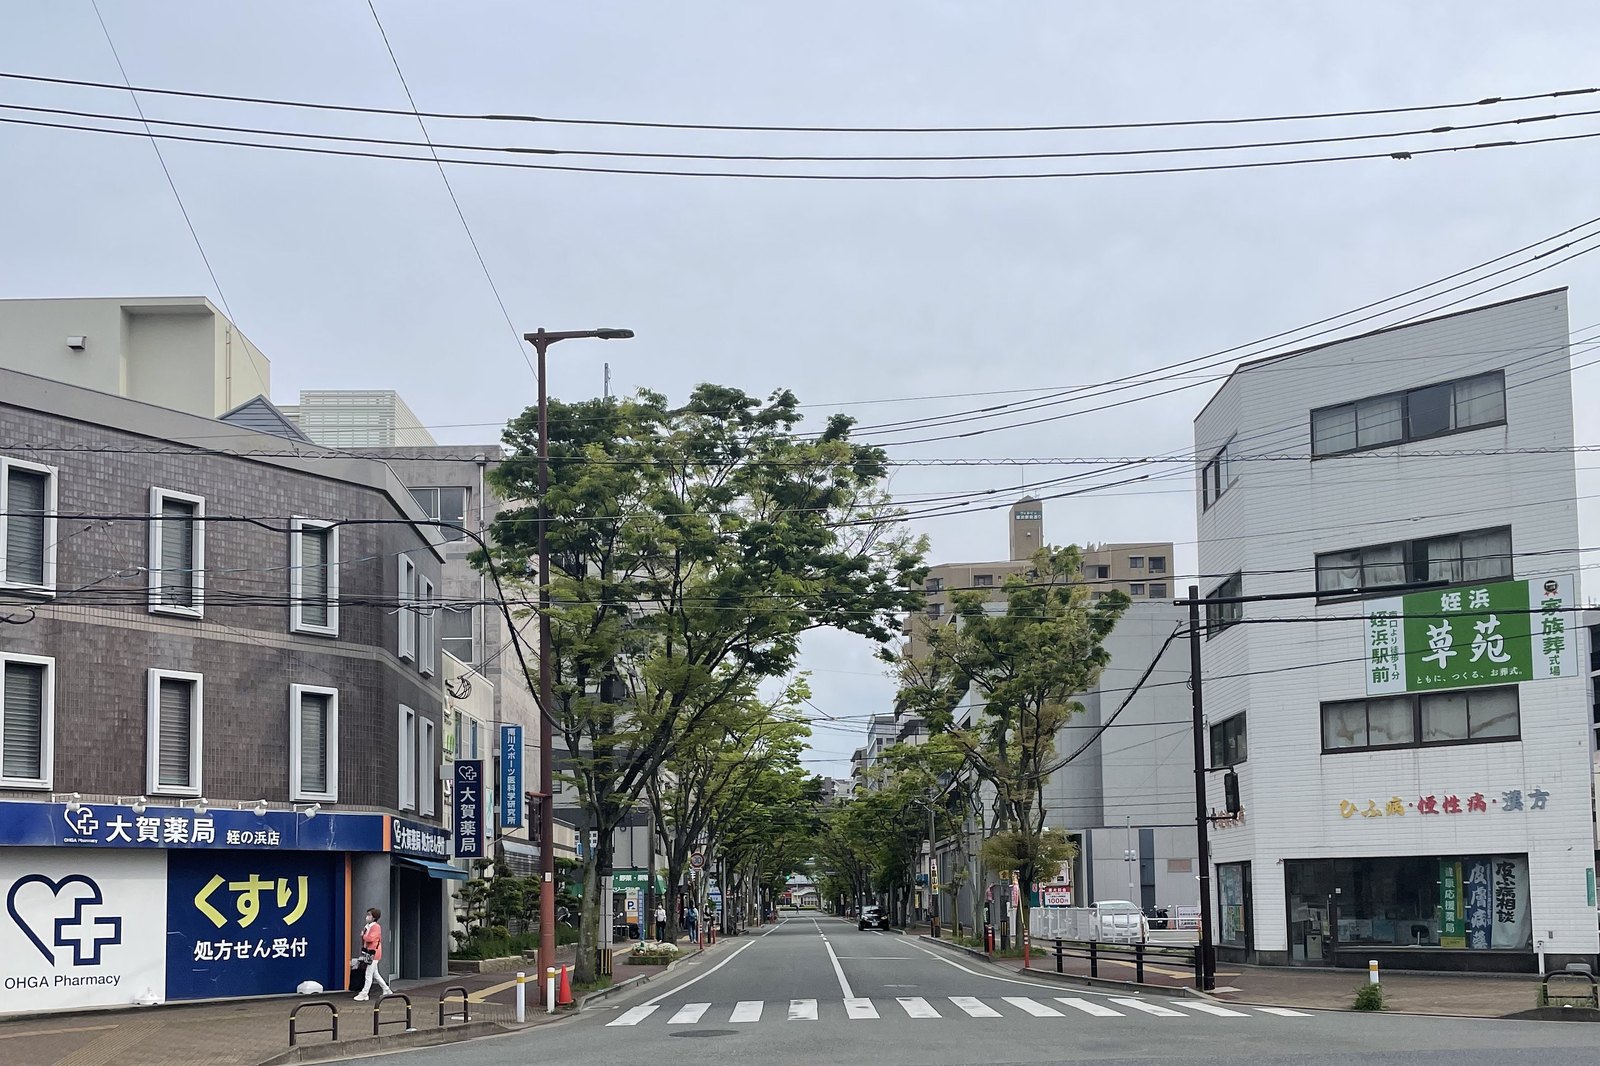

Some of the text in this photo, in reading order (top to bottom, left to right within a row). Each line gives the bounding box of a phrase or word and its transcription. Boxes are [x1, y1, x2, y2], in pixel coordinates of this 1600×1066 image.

[1441, 588, 1490, 612] 姪浜
[1370, 611, 1389, 683] 姪浜駅前
[1422, 614, 1511, 669] 草苑
[106, 815, 215, 844] 大賀薬局
[226, 830, 281, 846] 姪の浜店
[459, 787, 476, 853] 大賀薬局
[194, 874, 309, 929] くすり
[1495, 861, 1516, 923] 皮ふ病相談
[194, 937, 308, 961] 処方せん受付
[4, 974, 121, 990] OHGA Pharmacy
